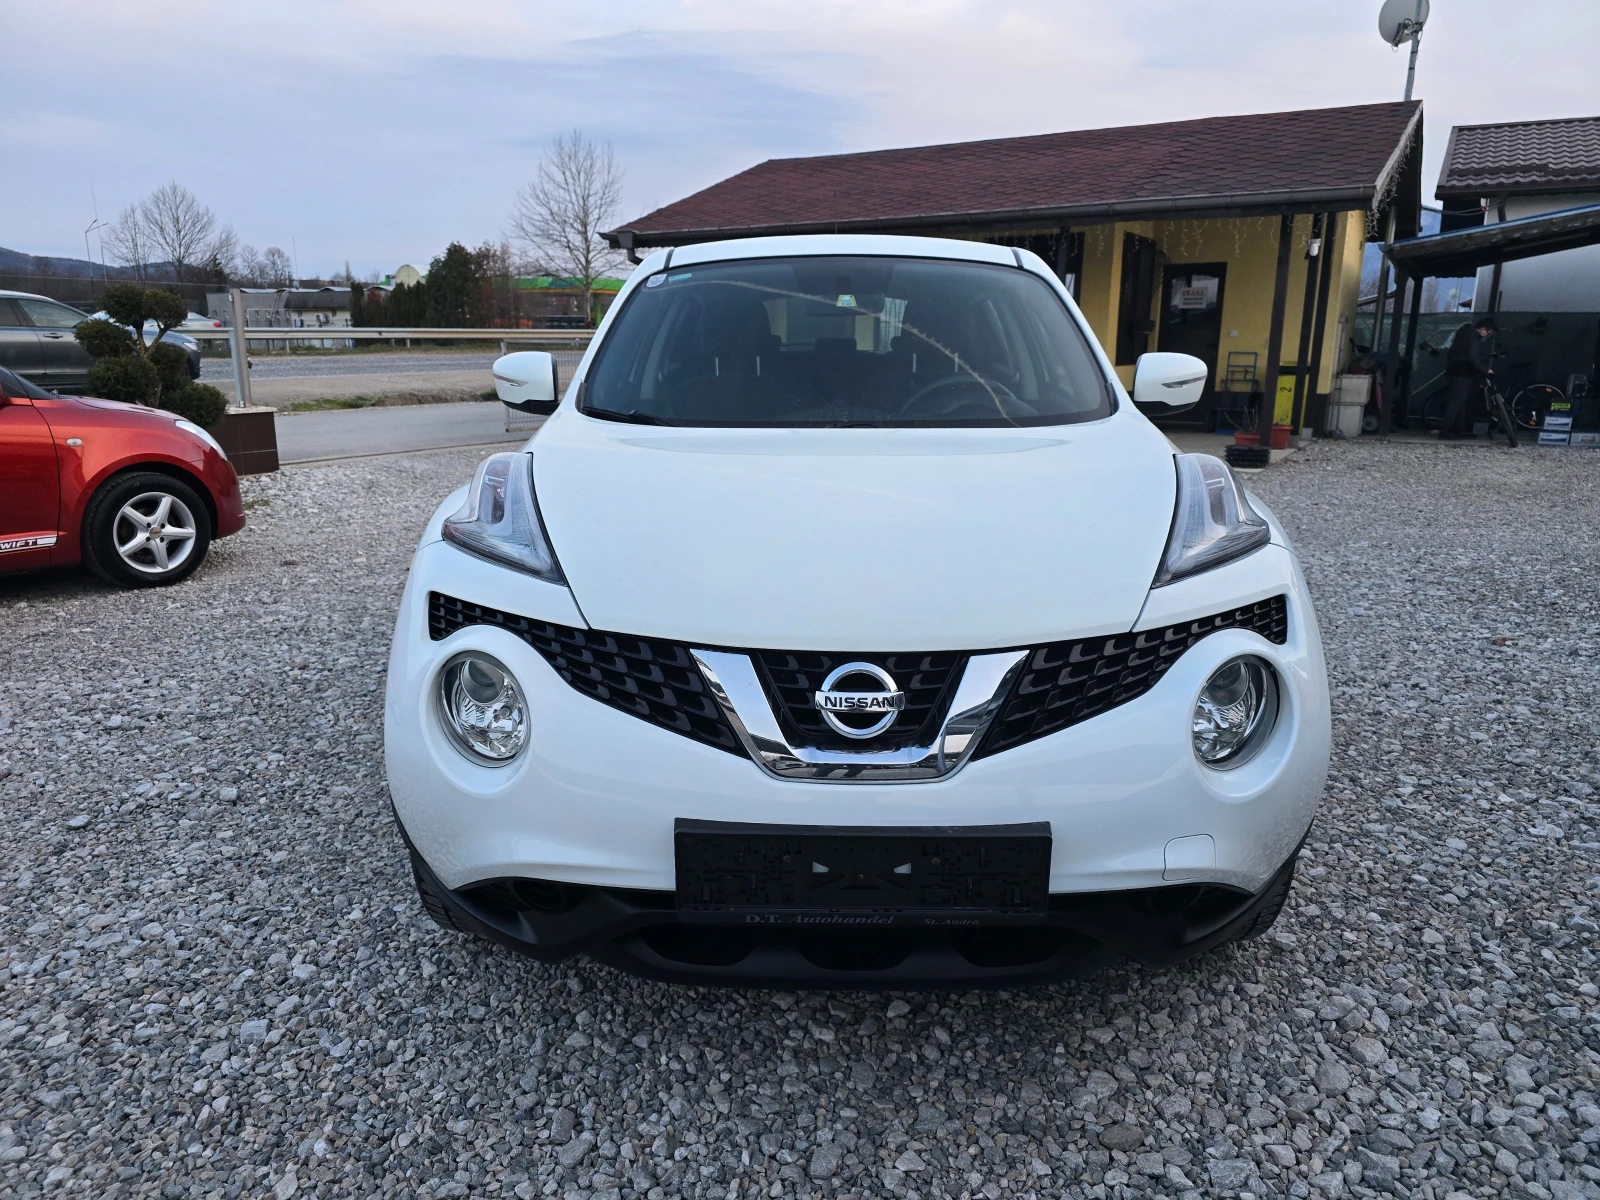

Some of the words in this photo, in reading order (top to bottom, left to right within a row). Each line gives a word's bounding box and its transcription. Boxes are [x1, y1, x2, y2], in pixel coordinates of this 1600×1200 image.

[0, 539, 36, 549] WIFT
[824, 695, 895, 709] NISSAN
[744, 914, 782, 923] D.T.
[787, 914, 896, 924] Autohandel
